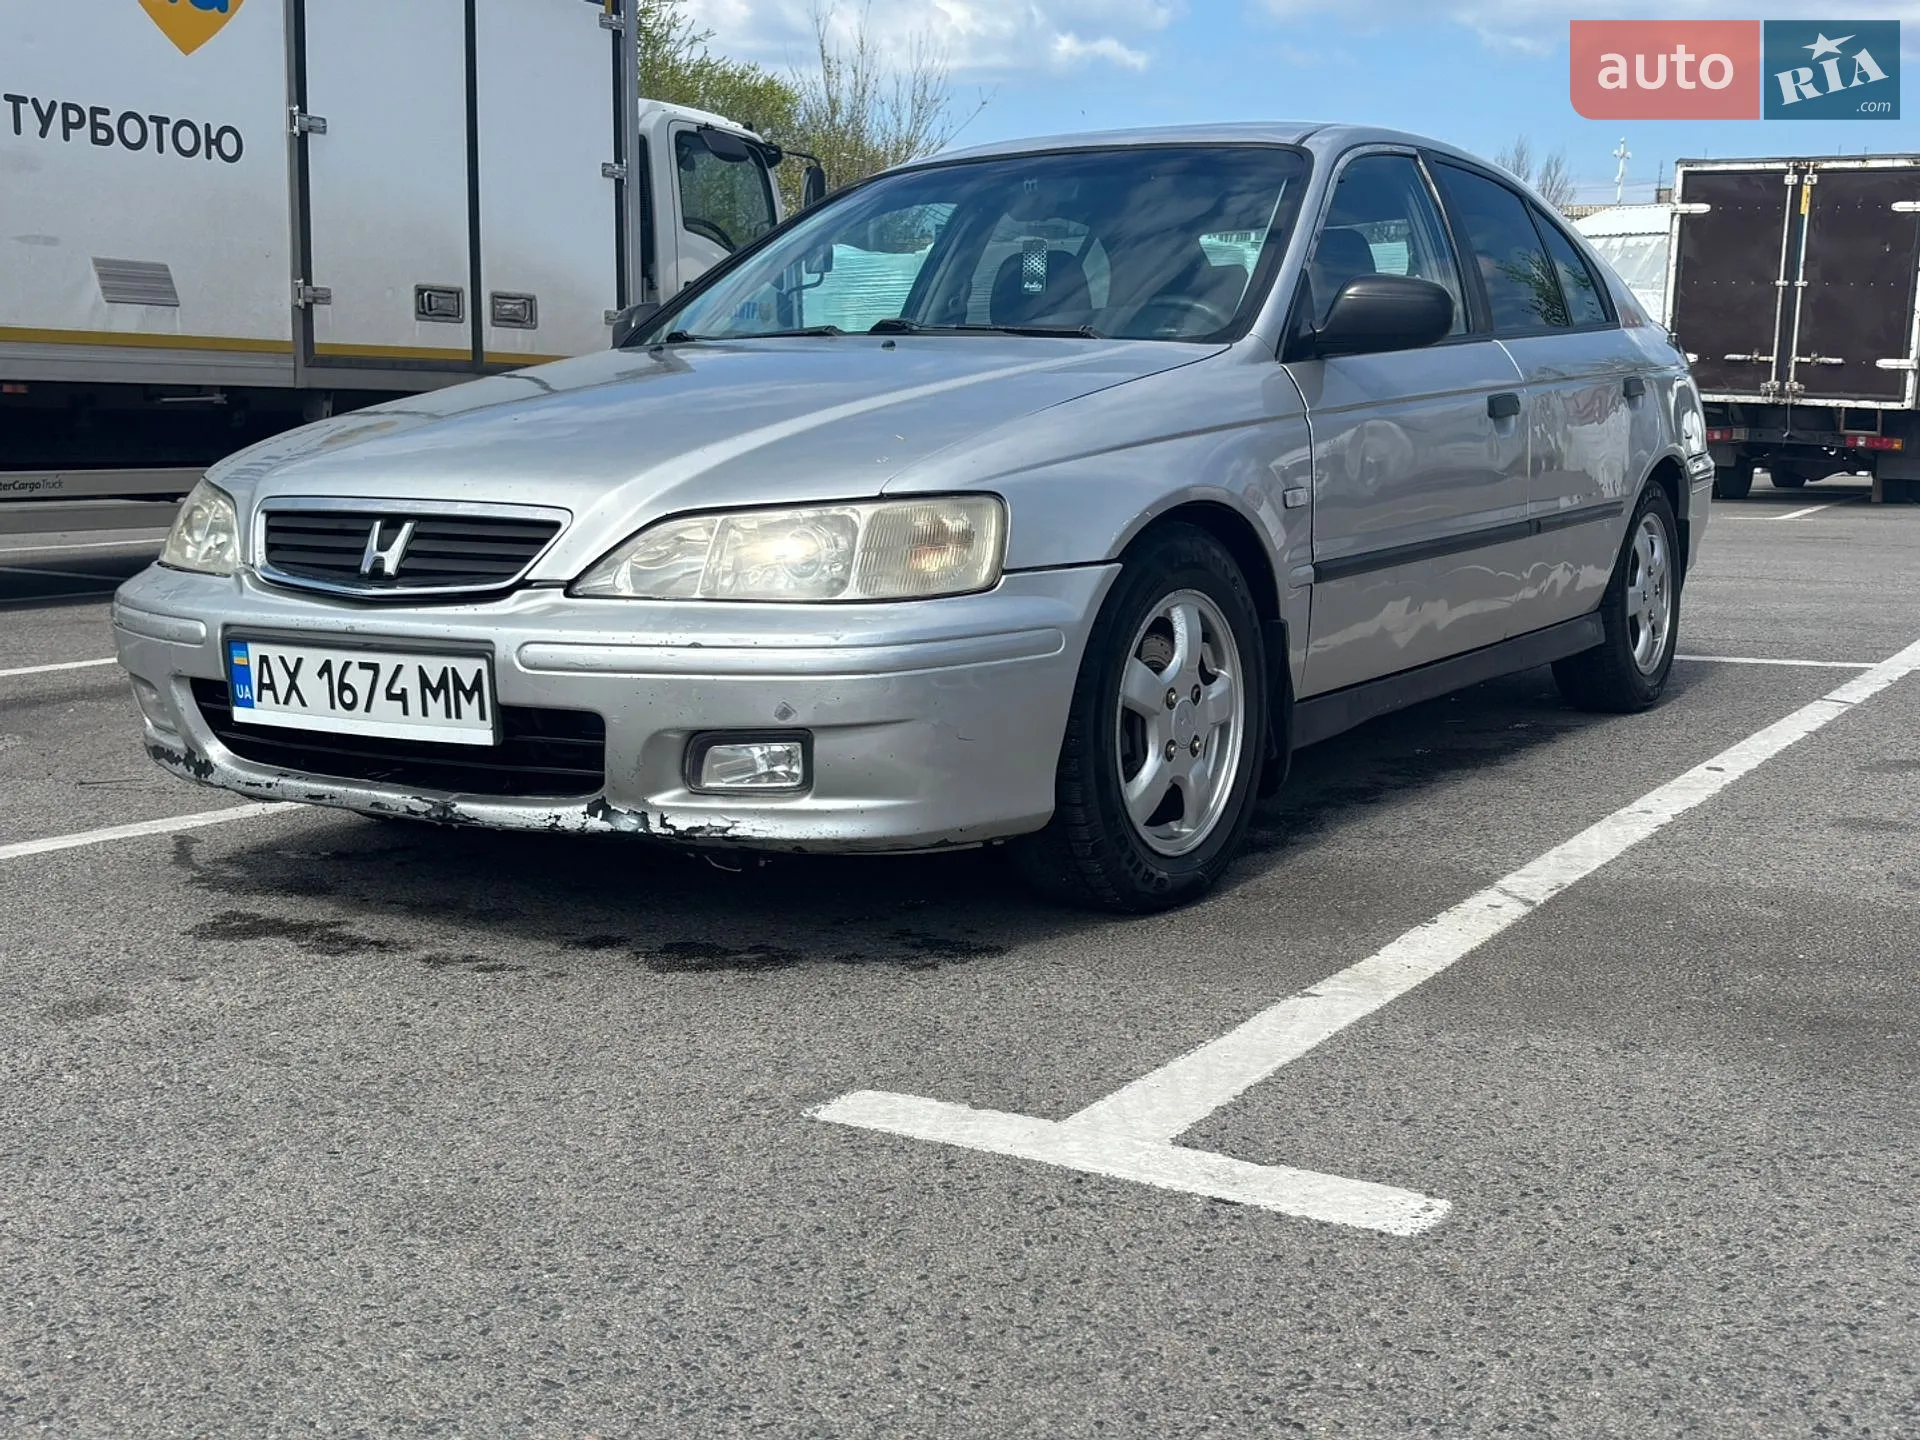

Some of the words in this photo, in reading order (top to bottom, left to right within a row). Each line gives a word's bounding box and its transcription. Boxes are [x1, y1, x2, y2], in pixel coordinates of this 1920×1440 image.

[4, 93, 243, 163] ТУРБОТОЮ
[236, 685, 252, 700] UA
[257, 655, 308, 707] AX
[317, 659, 410, 716] 1674
[418, 665, 487, 721] MM
